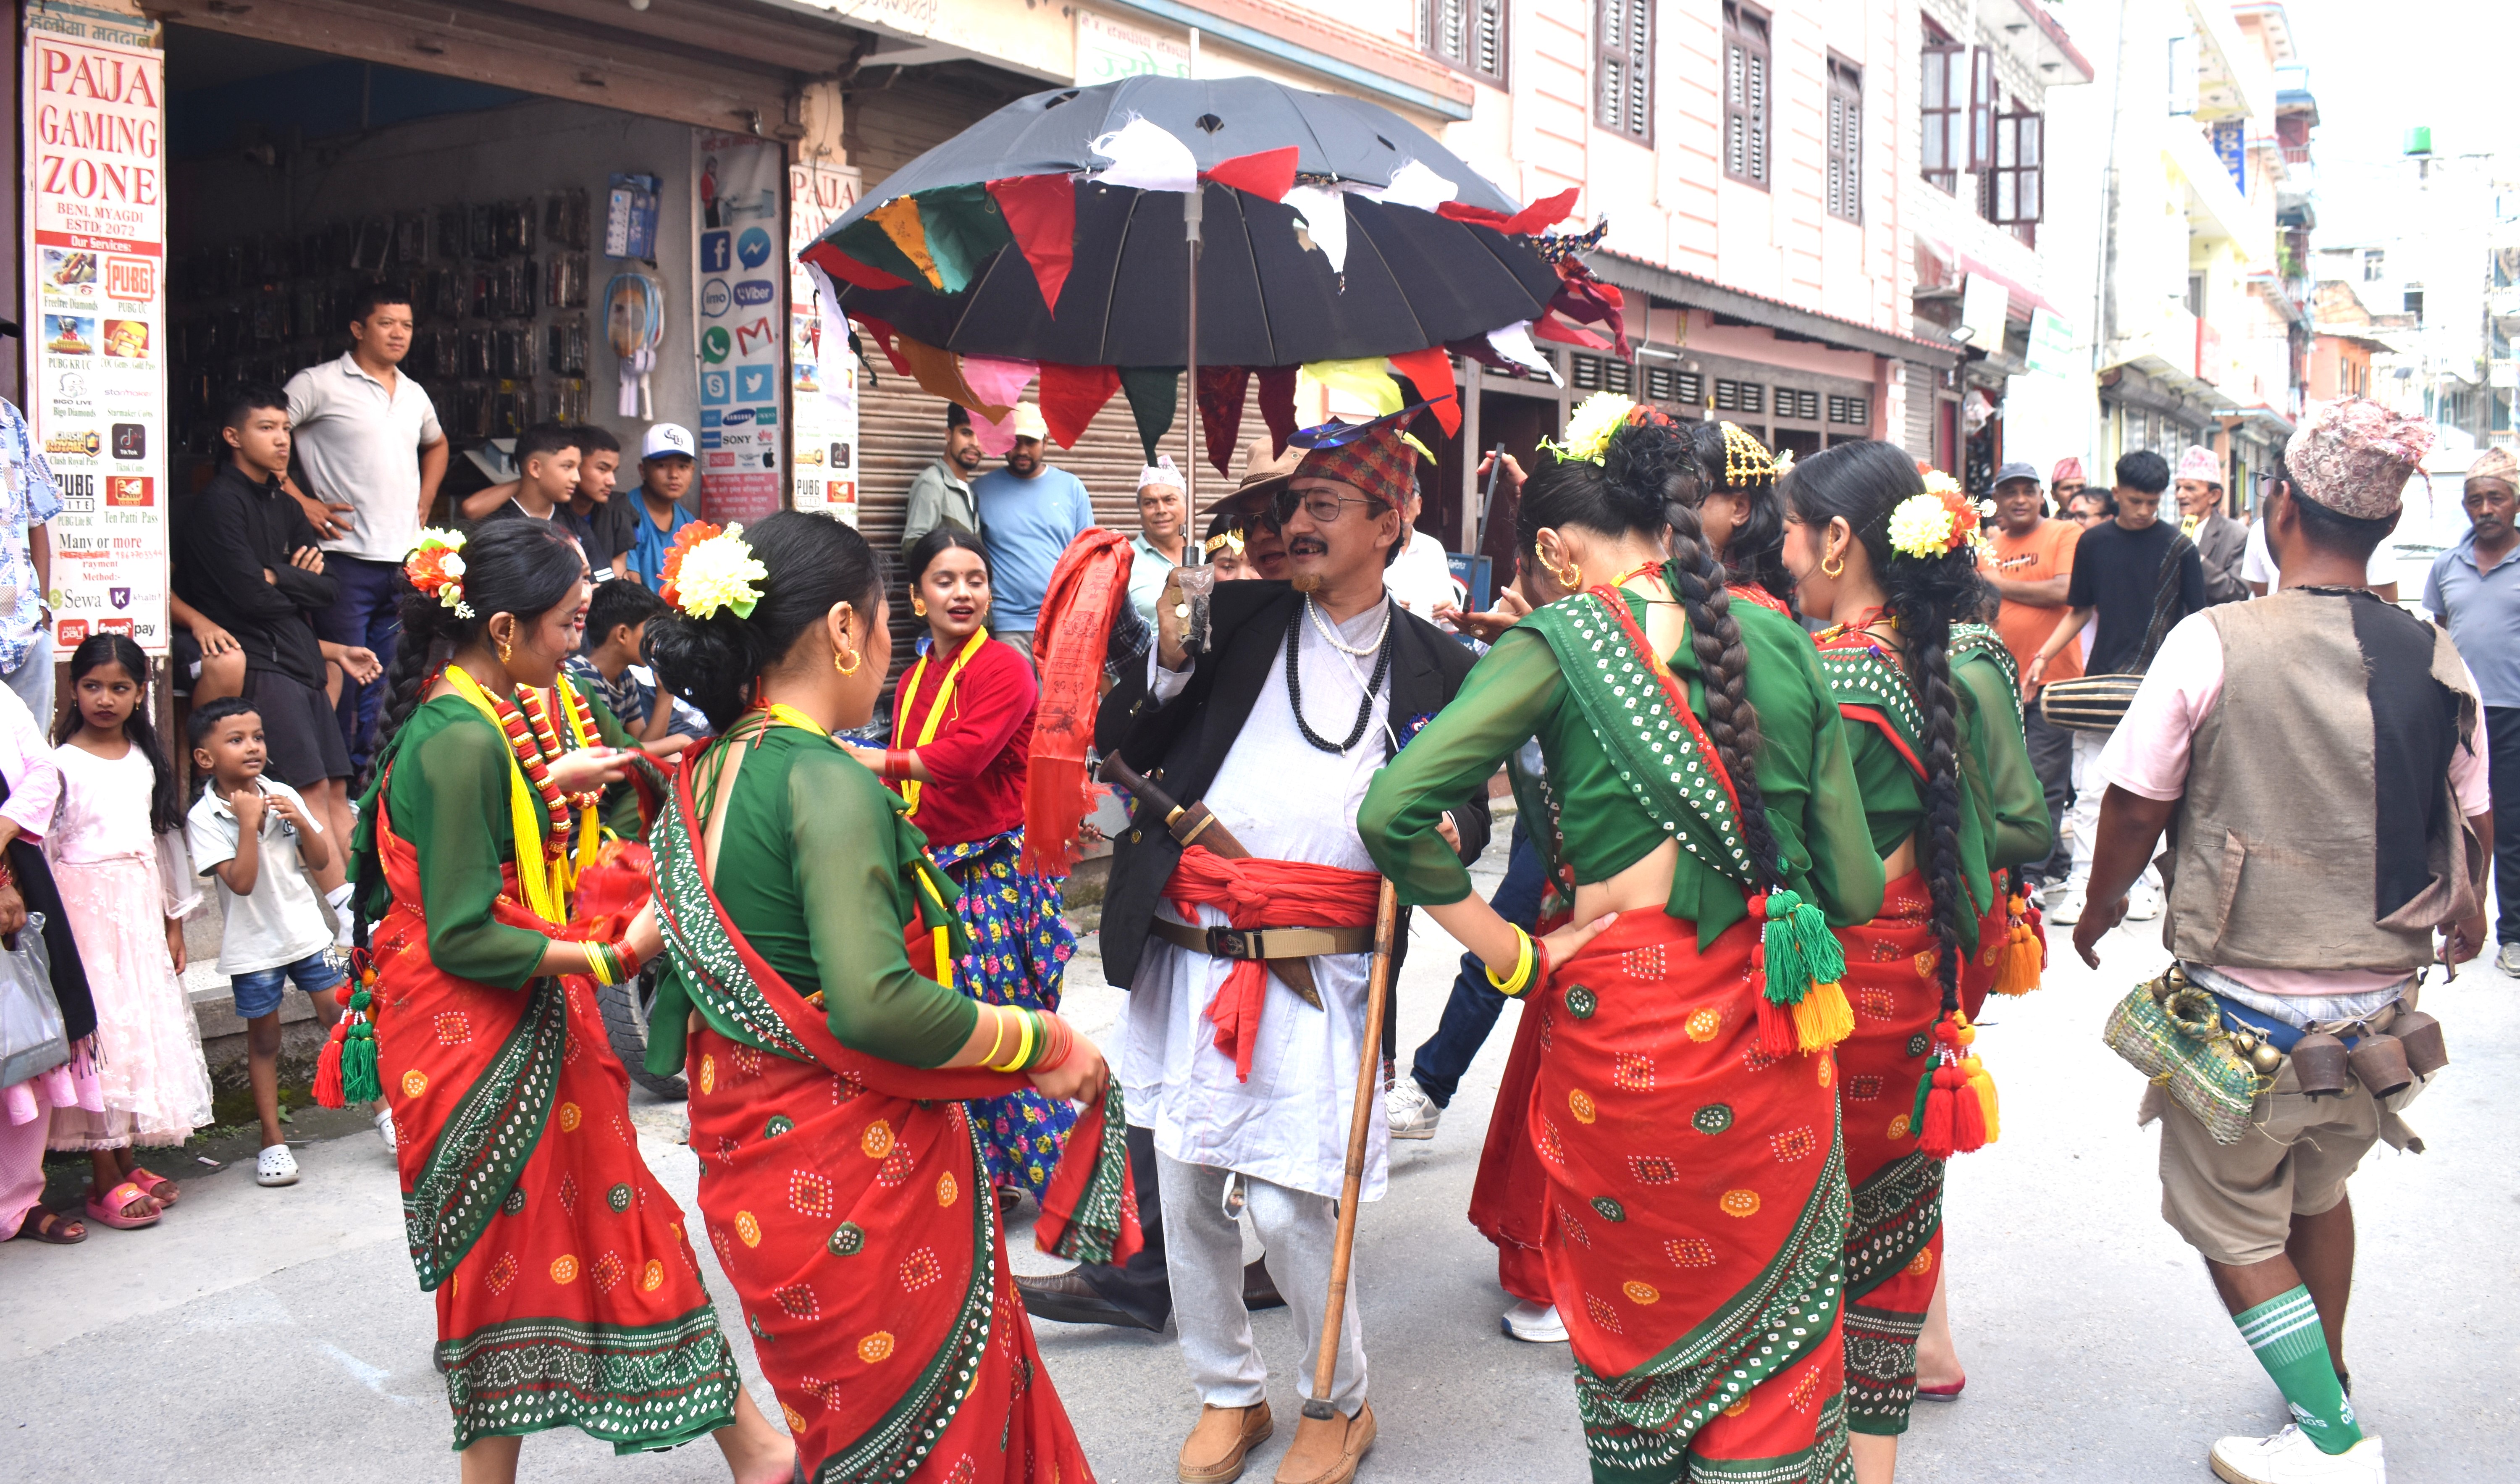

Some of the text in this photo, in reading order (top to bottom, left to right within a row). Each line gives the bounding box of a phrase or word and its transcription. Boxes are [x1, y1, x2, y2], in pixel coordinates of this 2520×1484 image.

[42, 48, 158, 108] PAJA
[40, 105, 157, 158] GAMING
[42, 155, 158, 205] ZONE
[791, 171, 856, 210] PAJA
[58, 202, 143, 223] BENI, MYAGDI
[66, 218, 134, 236] ESTD: 2072
[71, 235, 132, 252] Our Services:
[112, 265, 149, 294] PUBG
[706, 292, 726, 304] imo
[69, 298, 98, 311] Diamonds
[118, 302, 137, 314] PUBG
[49, 358, 68, 369] PUBG
[70, 359, 80, 369] KR
[53, 407, 96, 418] Bigo Diamonds
[108, 408, 136, 417] Starmaker
[56, 431, 84, 441] CLASH
[722, 435, 752, 444] SONY
[50, 456, 68, 465] Clash
[68, 457, 84, 467] Royal
[797, 479, 819, 495] PUBG
[68, 501, 89, 510] ITE
[58, 516, 74, 526] PUBG
[104, 511, 158, 524] Ten Patti Pass
[59, 533, 142, 551] Many or more
[83, 561, 118, 570] Payment
[62, 630, 84, 641] pay
[134, 624, 155, 636] pay
